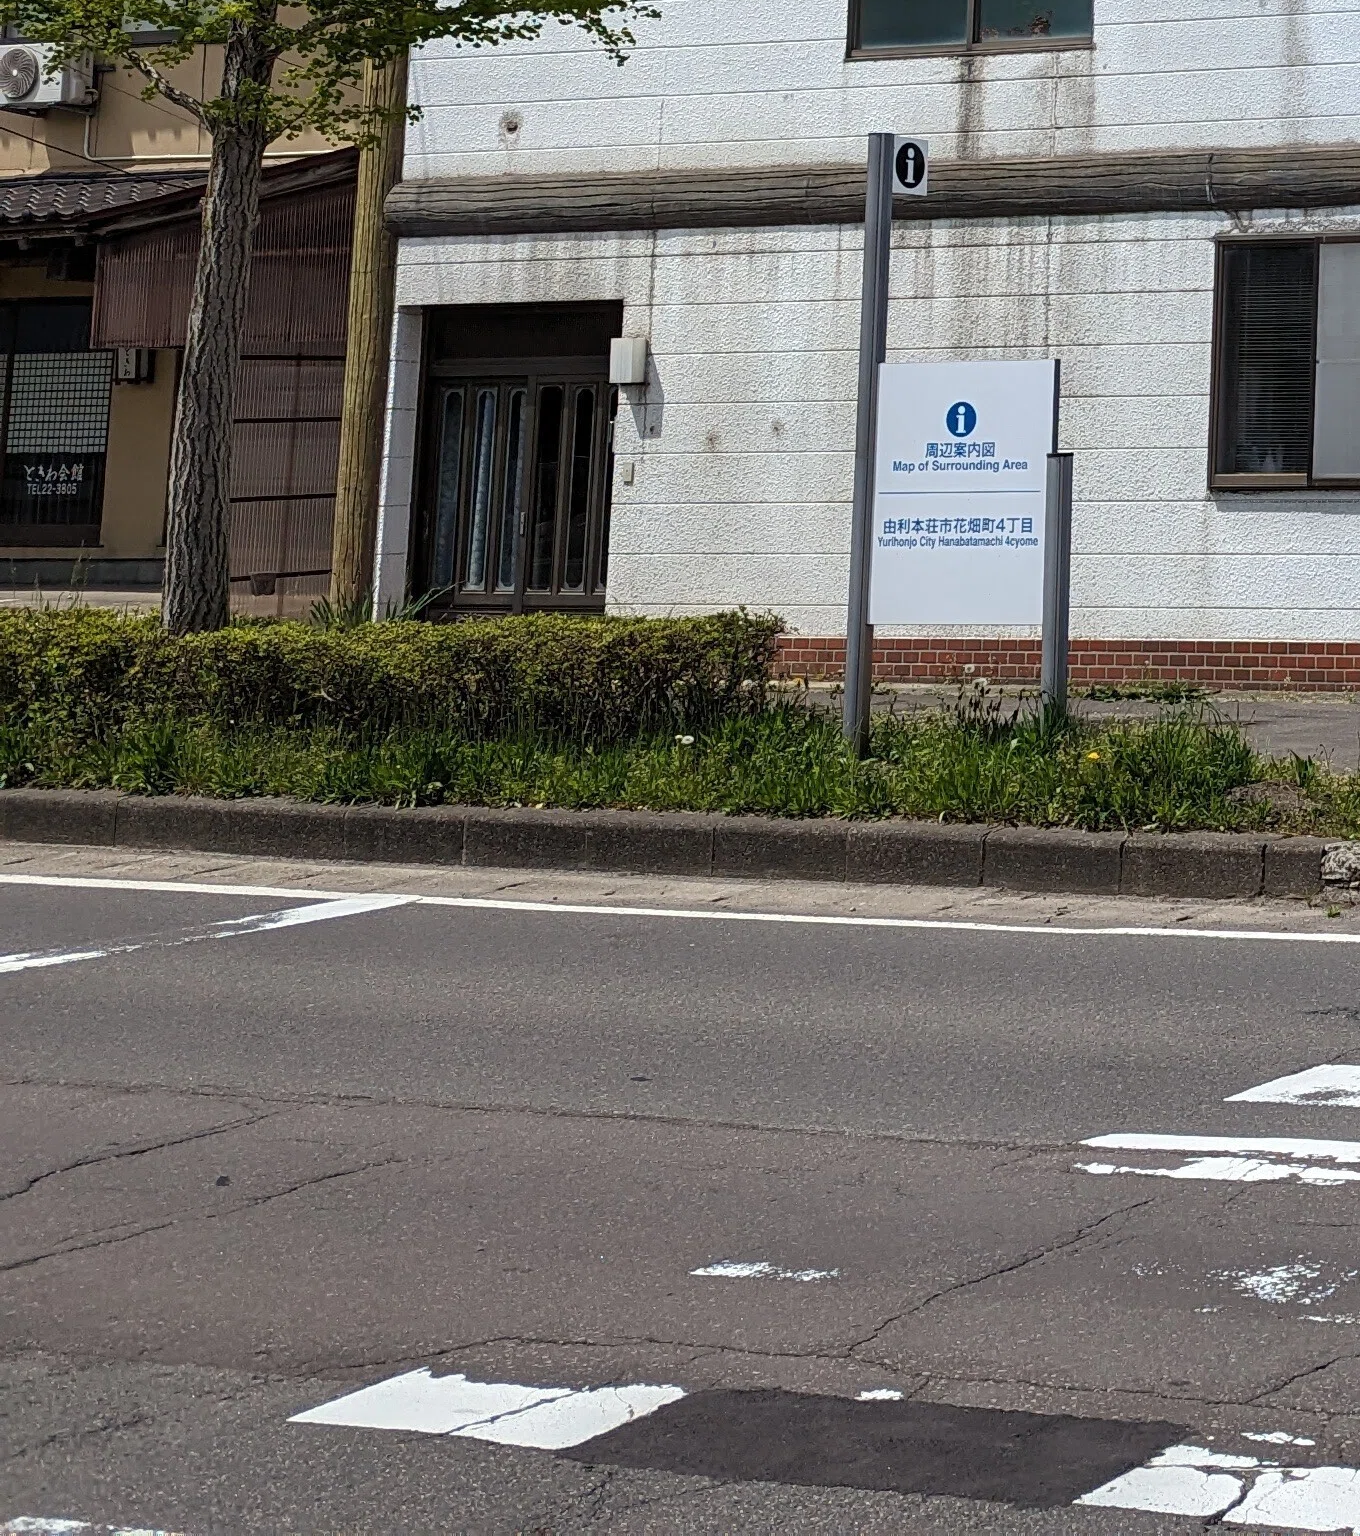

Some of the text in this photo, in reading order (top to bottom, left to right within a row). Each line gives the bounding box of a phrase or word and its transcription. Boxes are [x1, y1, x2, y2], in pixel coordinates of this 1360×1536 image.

[925, 441, 996, 459] 周辺案内図
[892, 458, 1029, 474] Map of Surrounding Area
[883, 517, 1033, 535] 由利本荘市花畑町4丁目
[878, 534, 1039, 550] Yurihonjo City Hanabatamachi 4cyome
